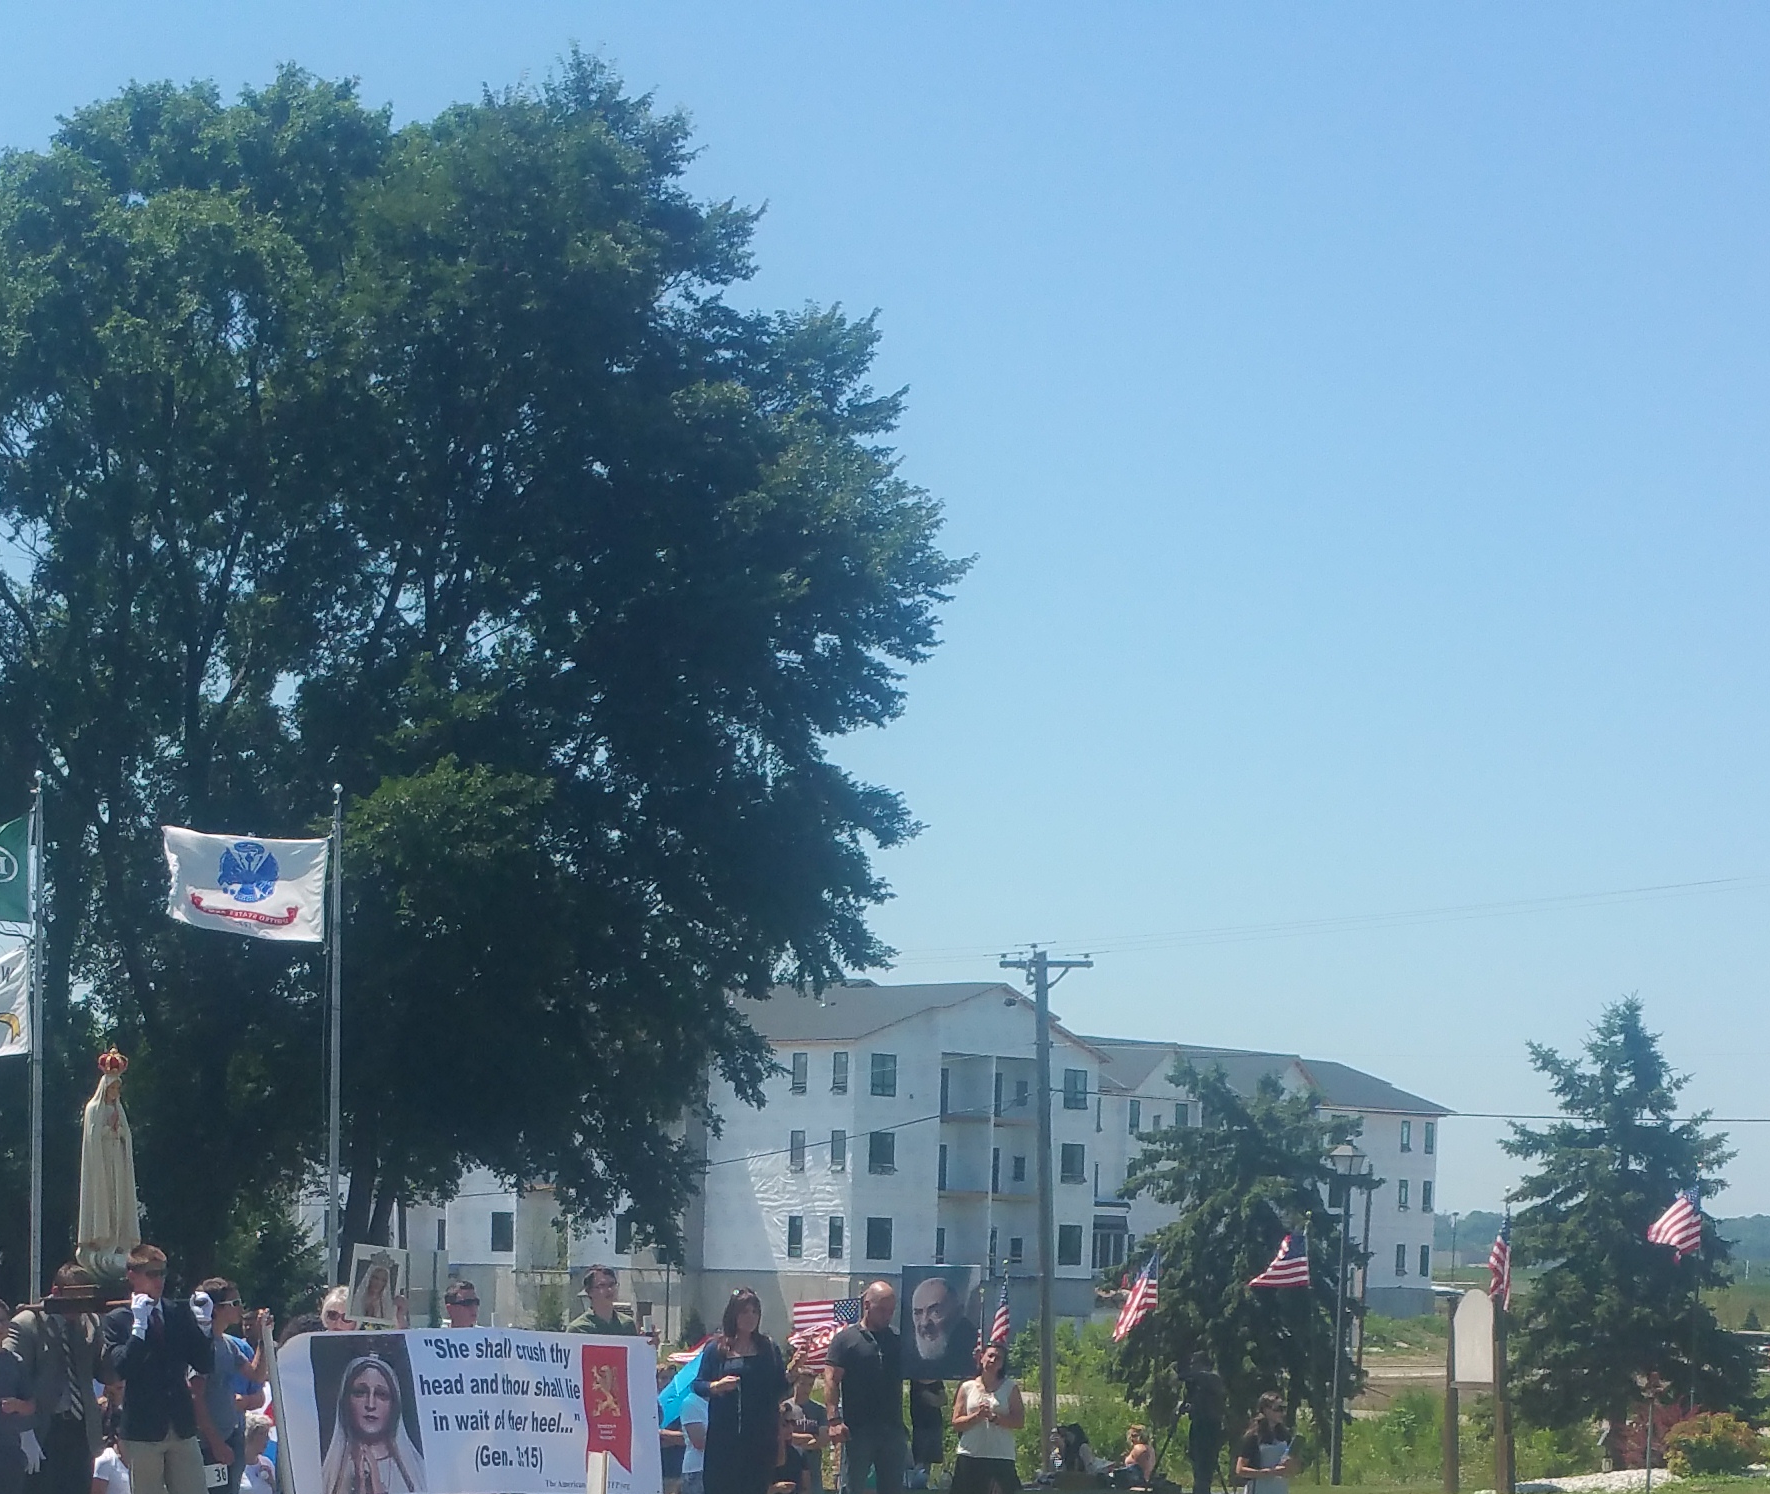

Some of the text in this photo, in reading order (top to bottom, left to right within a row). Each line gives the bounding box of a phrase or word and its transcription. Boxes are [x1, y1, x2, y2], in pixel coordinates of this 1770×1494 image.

[424, 1338, 571, 1369] "She shall crush thy
[419, 1374, 464, 1396] head
[470, 1373, 499, 1395] and
[502, 1373, 529, 1396] thou
[565, 1379, 581, 1399] lie
[432, 1410, 450, 1432] in
[455, 1410, 490, 1433] wait
[507, 1410, 528, 1433] her
[475, 1445, 543, 1474] (Gen. 3:15)
[214, 1467, 227, 1482] 36
